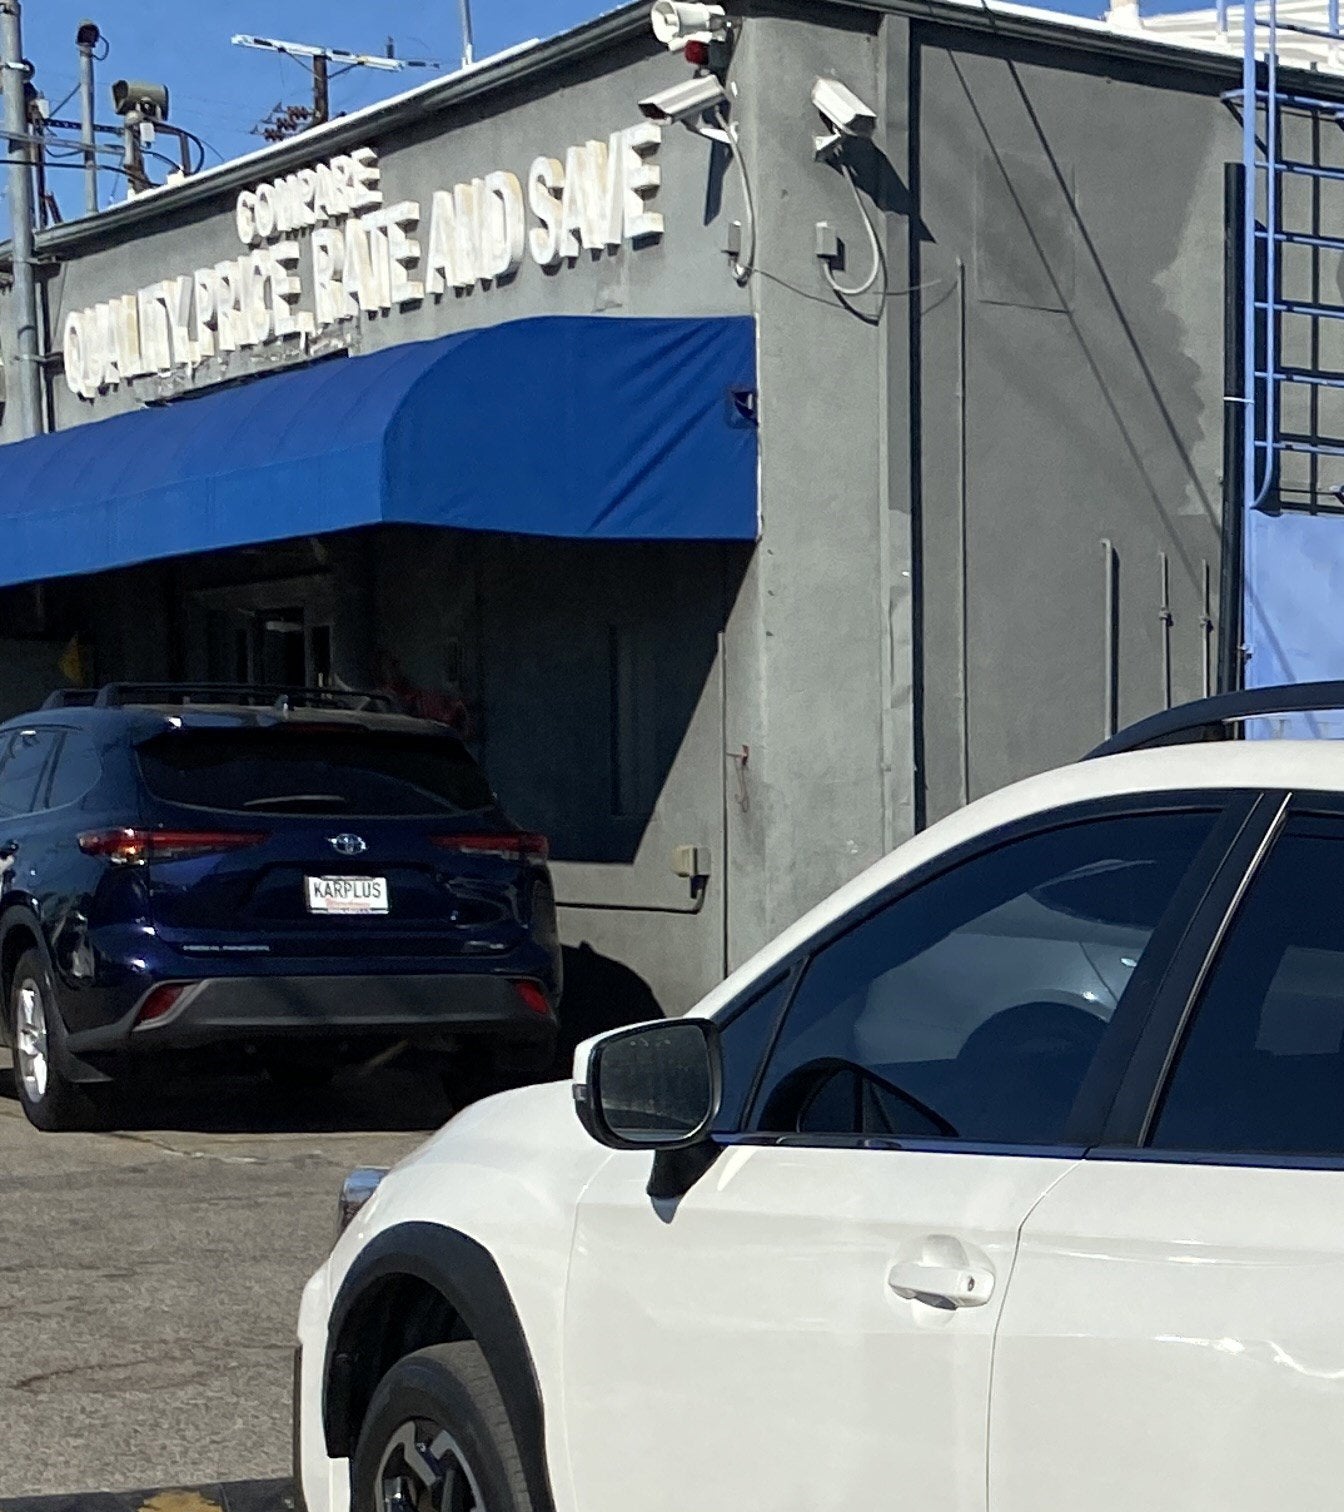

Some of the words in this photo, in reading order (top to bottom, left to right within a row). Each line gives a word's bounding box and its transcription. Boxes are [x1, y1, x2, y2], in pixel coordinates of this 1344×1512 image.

[236, 147, 383, 244] COMPARE
[311, 201, 425, 325] RATE
[426, 170, 526, 294] AND
[528, 121, 665, 267] SAVE
[313, 880, 382, 899] KARPLUS
